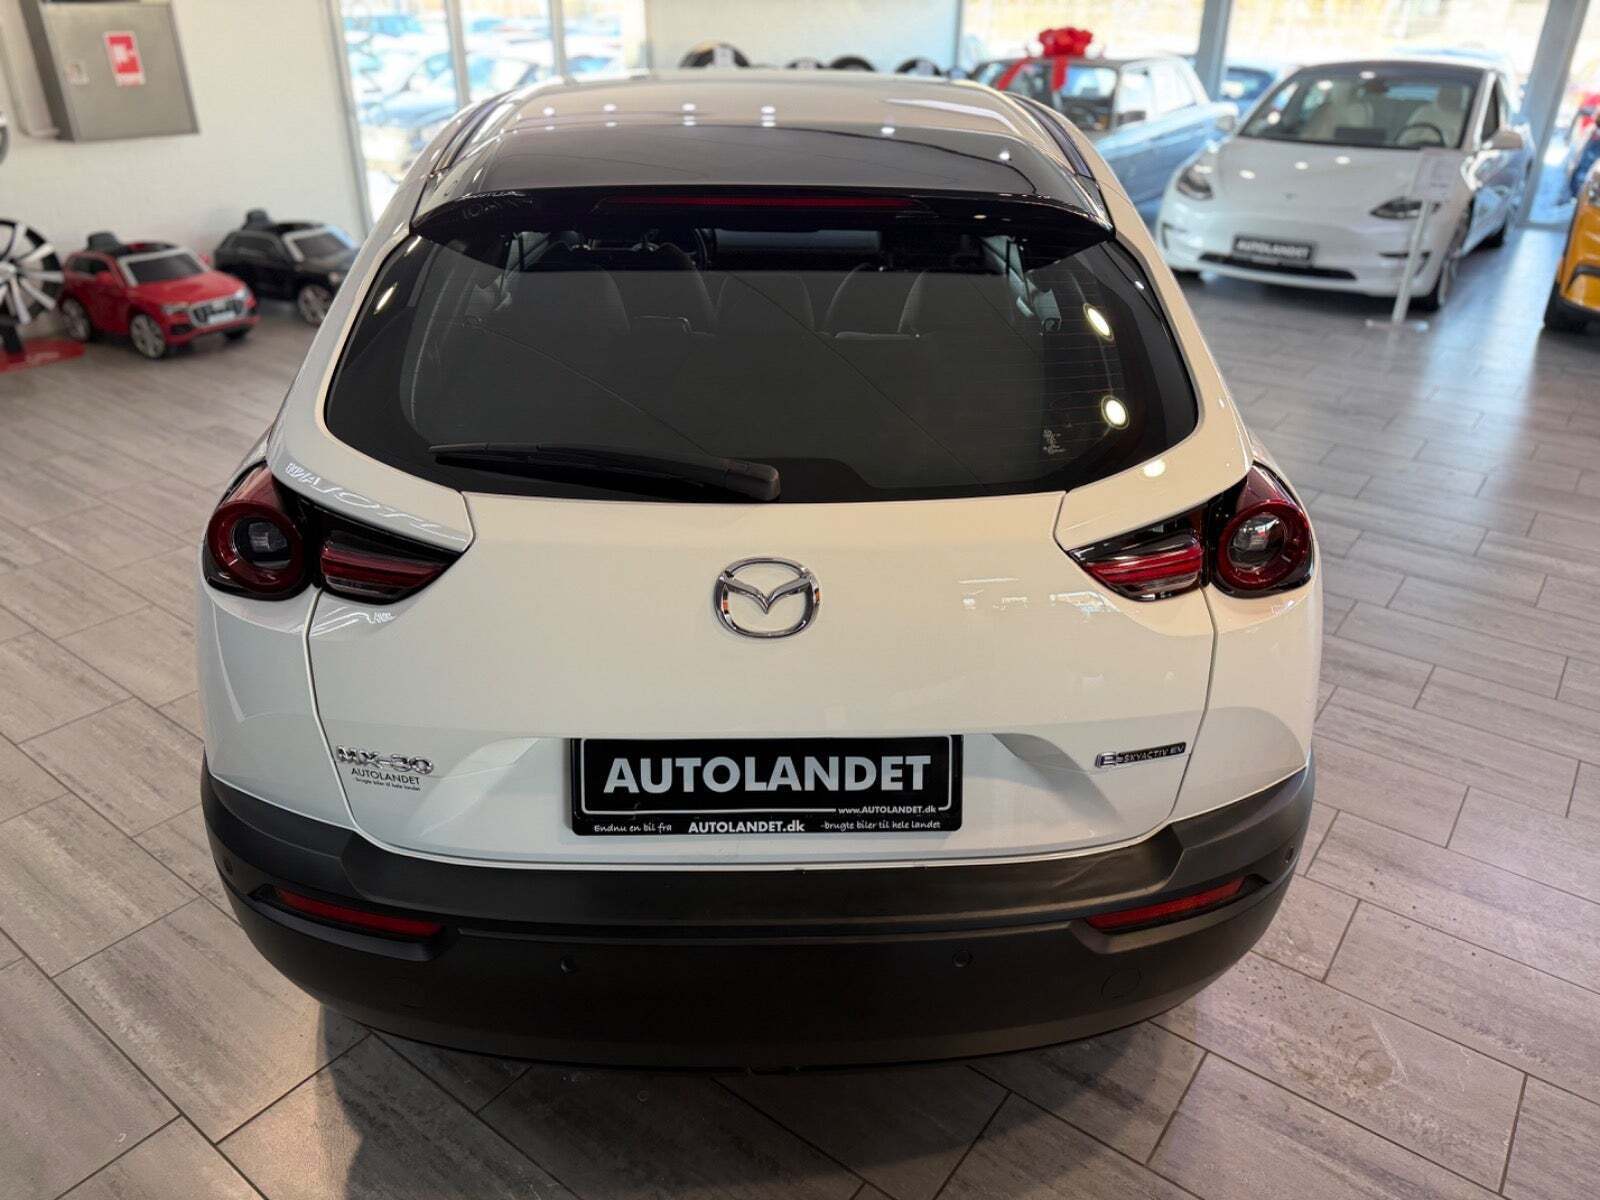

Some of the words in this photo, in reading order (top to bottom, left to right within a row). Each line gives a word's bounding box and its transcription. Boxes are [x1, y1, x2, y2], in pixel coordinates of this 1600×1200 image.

[336, 746, 433, 775] MX-30
[351, 767, 421, 785] AUTOLANDET
[603, 756, 931, 793] AUTOLANDET
[838, 805, 936, 815] www.AUTOLANDET.dk
[594, 824, 627, 832] Endnu
[643, 824, 655, 832] bil
[658, 824, 672, 834] fra
[689, 820, 806, 833] AUTOLANDET.dk
[857, 821, 876, 829] biler
[878, 821, 889, 829] til
[892, 821, 910, 829] hele
[911, 821, 941, 829] landet
